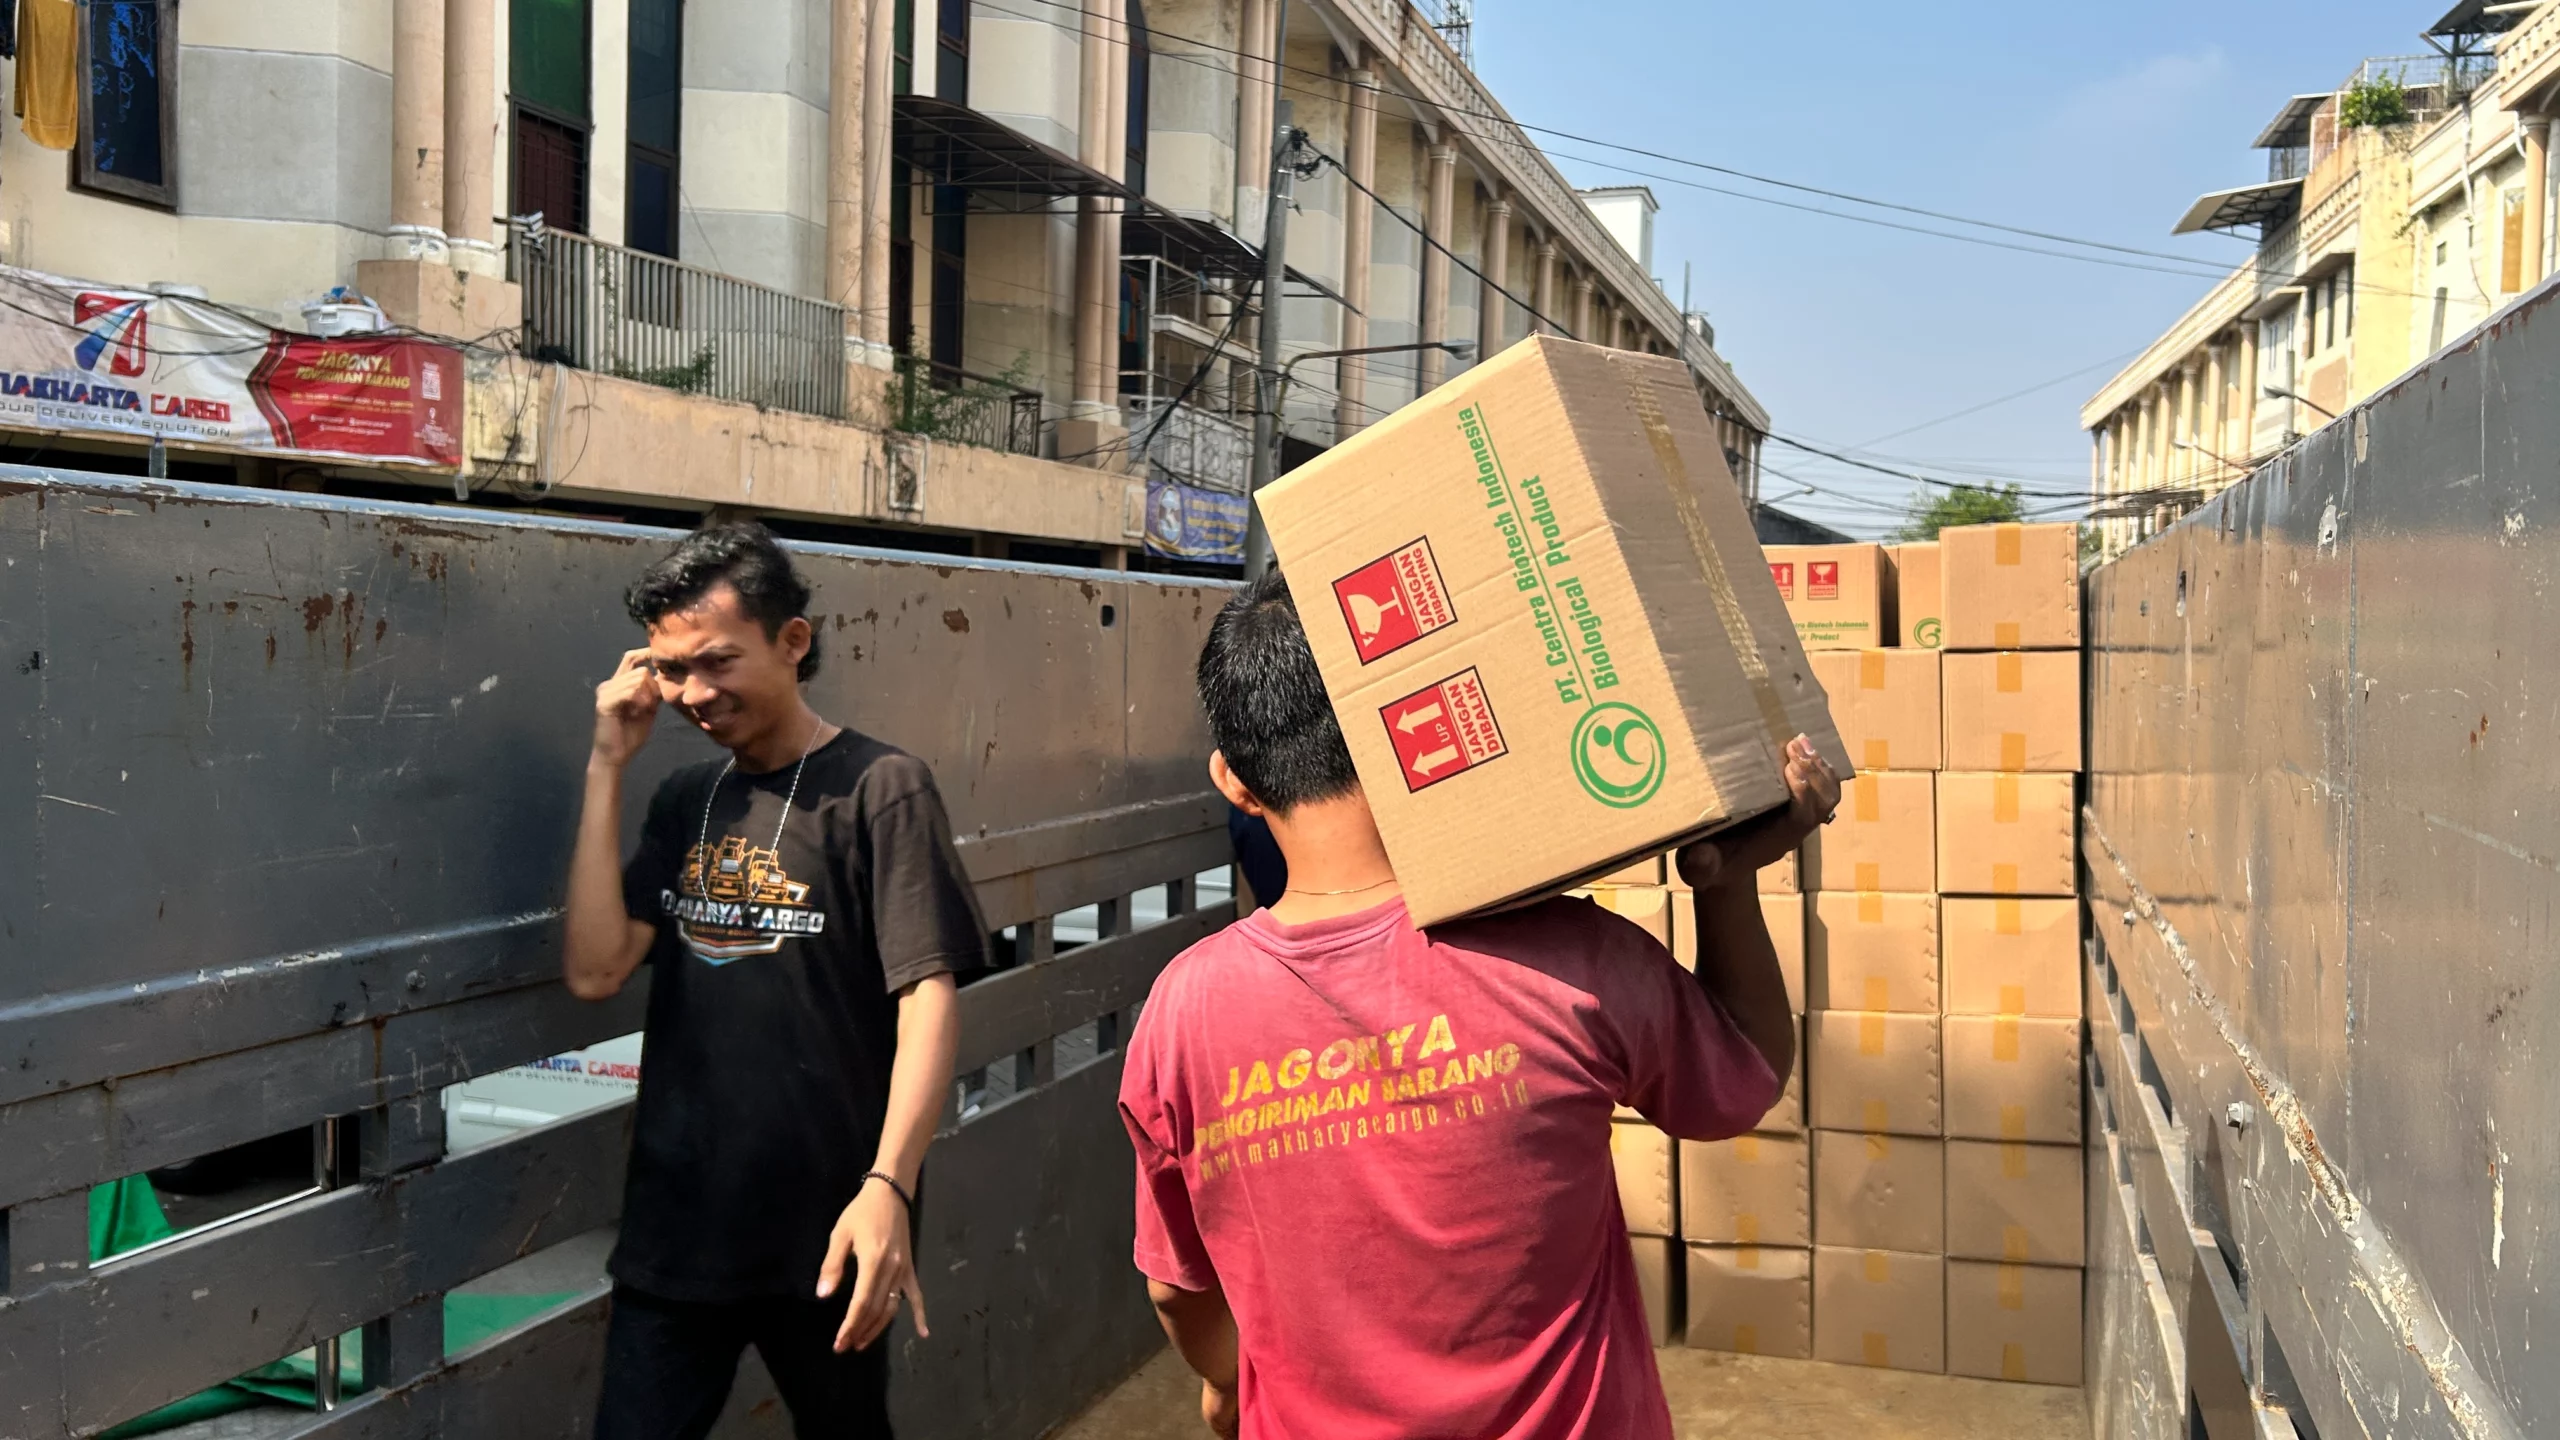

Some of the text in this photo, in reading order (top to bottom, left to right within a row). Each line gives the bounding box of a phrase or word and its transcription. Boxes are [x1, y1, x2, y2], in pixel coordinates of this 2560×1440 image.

[316, 349, 391, 374] JAGONYA
[42, 406, 135, 425] DELIVERY
[141, 420, 230, 438] SOLUTION
[151, 394, 231, 422] CARGO
[1399, 552, 1435, 628] JANGAN
[1412, 547, 1447, 625] DIBANTING
[1457, 407, 1582, 704] PT. Centra Biotech Indonesia
[1520, 475, 1620, 690] Biological Product
[1435, 723, 1450, 743] UP
[1448, 684, 1485, 758] JANGAN
[1463, 677, 1500, 754] DIBALIK
[1222, 1014, 1457, 1107] JAGONYA
